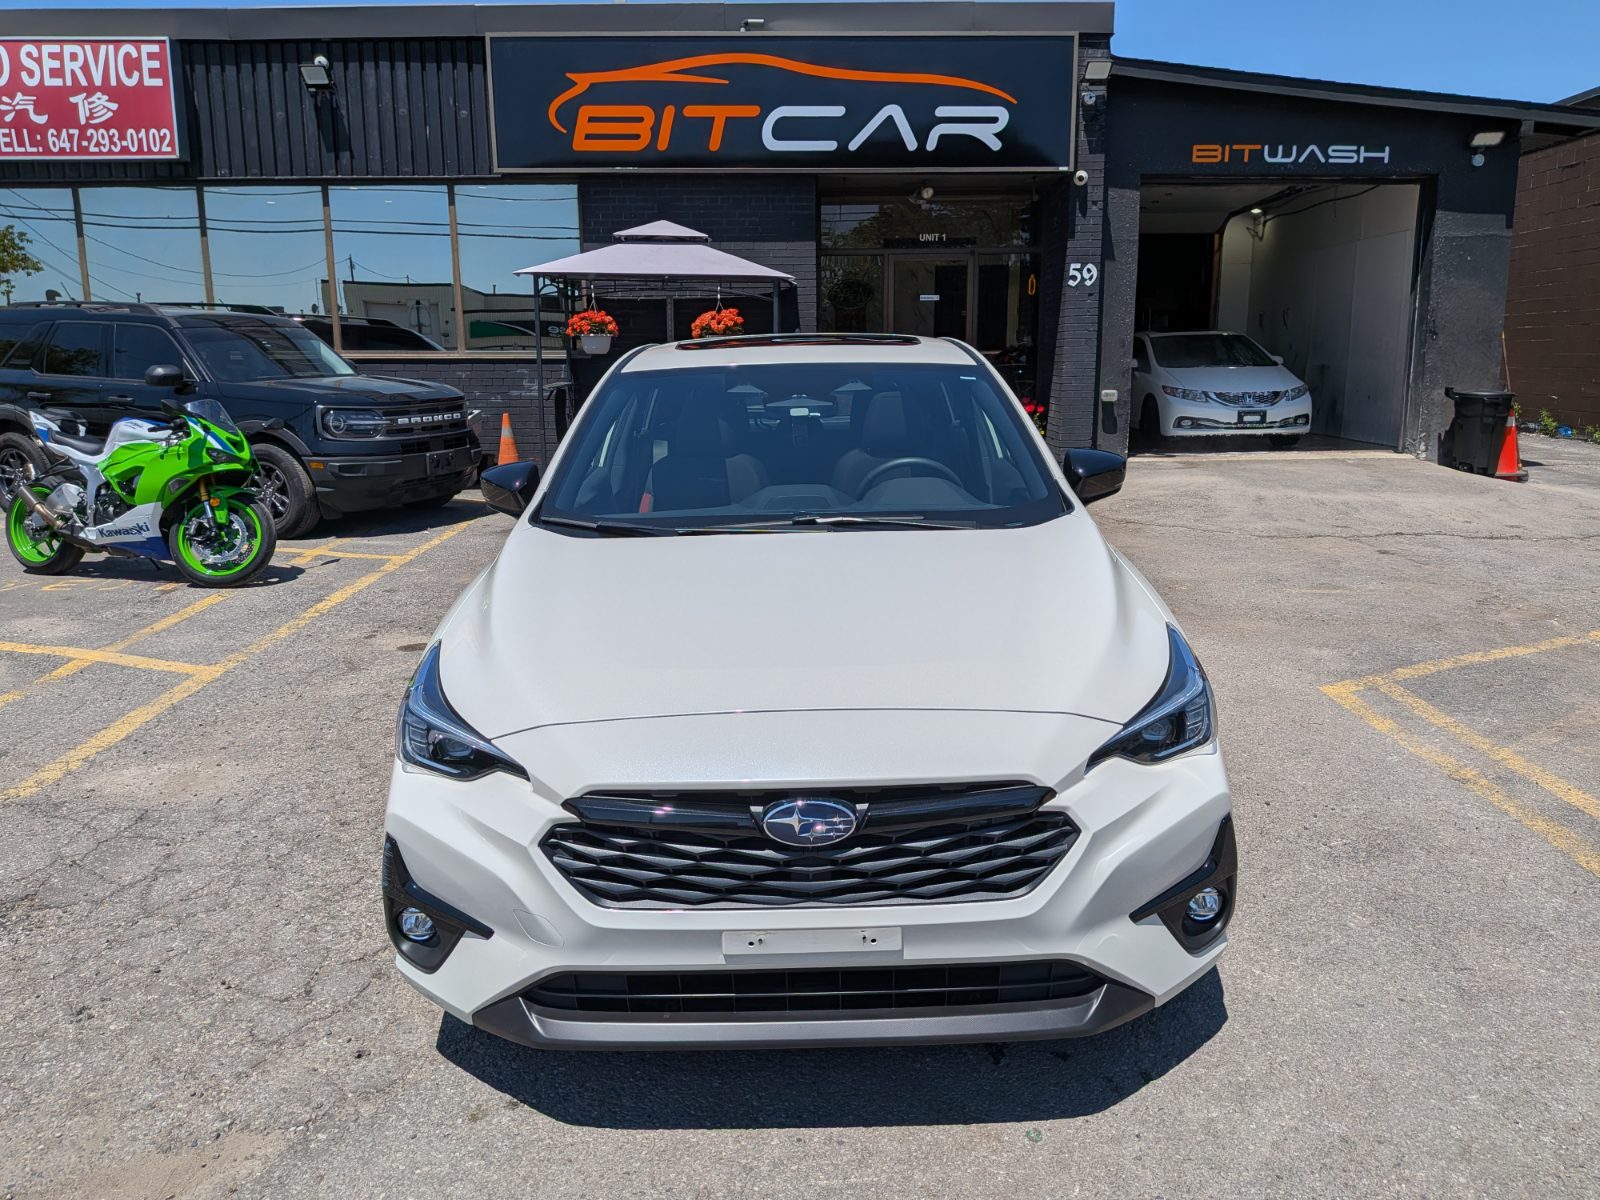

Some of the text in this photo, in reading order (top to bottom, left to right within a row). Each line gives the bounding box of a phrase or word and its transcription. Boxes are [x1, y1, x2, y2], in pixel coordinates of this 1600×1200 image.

[20, 44, 163, 87] SERVICE
[572, 104, 1010, 152] BITCAR
[48, 128, 172, 153] 647-293-0102
[1192, 144, 1390, 164] BITWASH
[919, 233, 947, 242] UNIT 1
[1067, 263, 1098, 287] 59
[397, 413, 461, 425] BRONCO
[98, 521, 151, 538] Kawasaki
